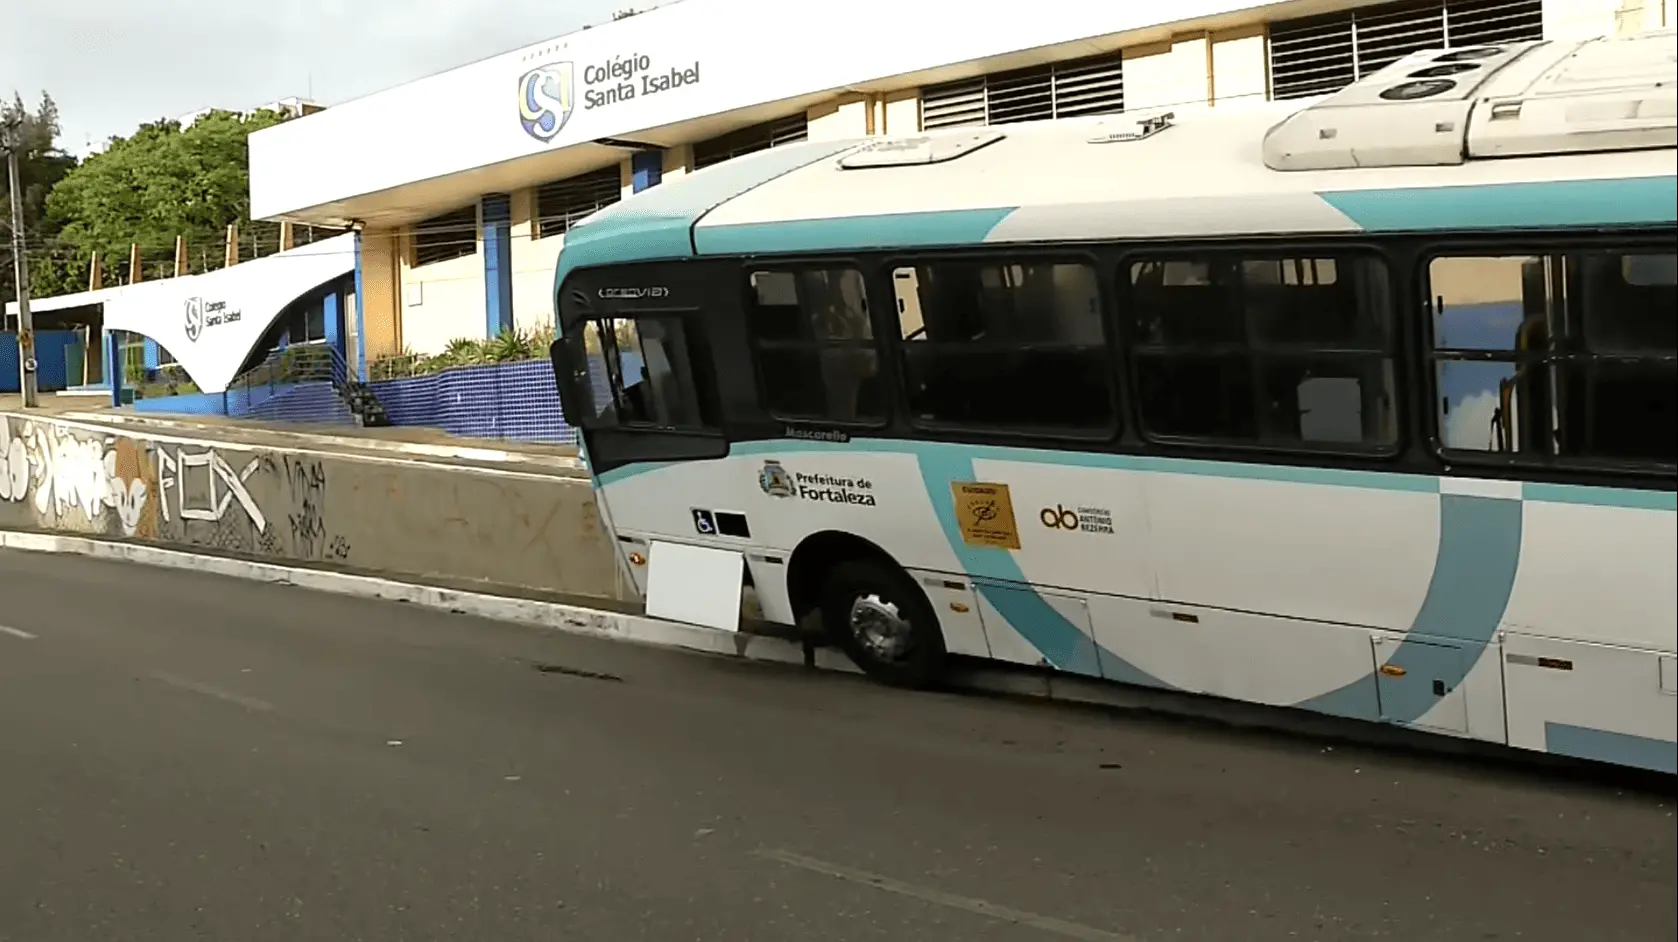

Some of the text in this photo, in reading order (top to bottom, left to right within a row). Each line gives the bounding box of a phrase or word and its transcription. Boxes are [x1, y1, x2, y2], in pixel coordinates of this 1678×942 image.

[584, 53, 650, 85] Colégio
[584, 61, 700, 110] Santa Isabel
[156, 446, 267, 535] FOX
[796, 472, 873, 489] Prefeitura de
[799, 485, 876, 506] Fortaleza
